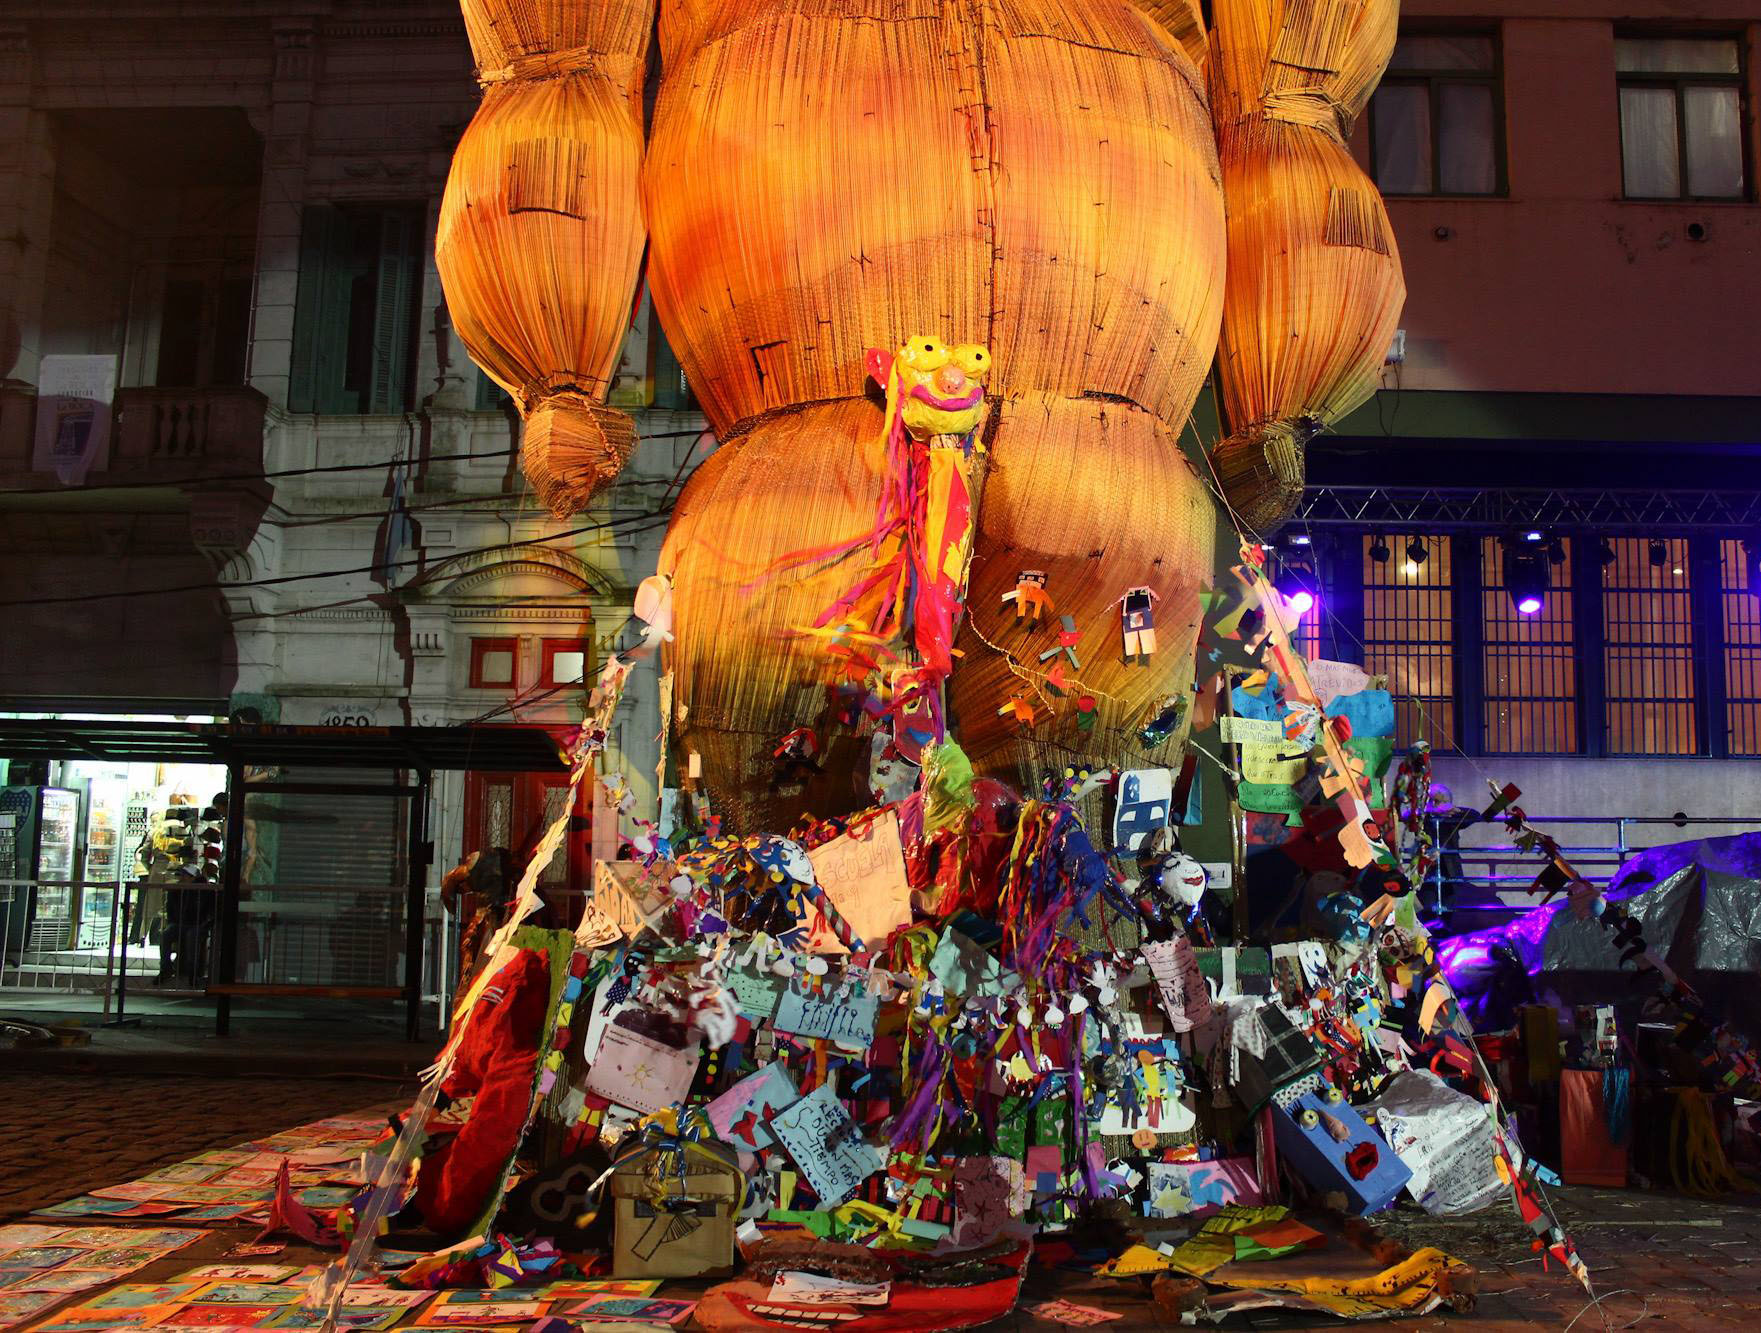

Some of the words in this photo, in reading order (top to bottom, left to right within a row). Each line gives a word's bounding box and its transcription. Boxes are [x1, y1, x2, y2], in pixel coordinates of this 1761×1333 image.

[821, 832, 897, 887] SCUELA
[808, 1137, 839, 1186] TIEMPO
[811, 1118, 843, 1163] DUN
[839, 1163, 860, 1187] MAS
